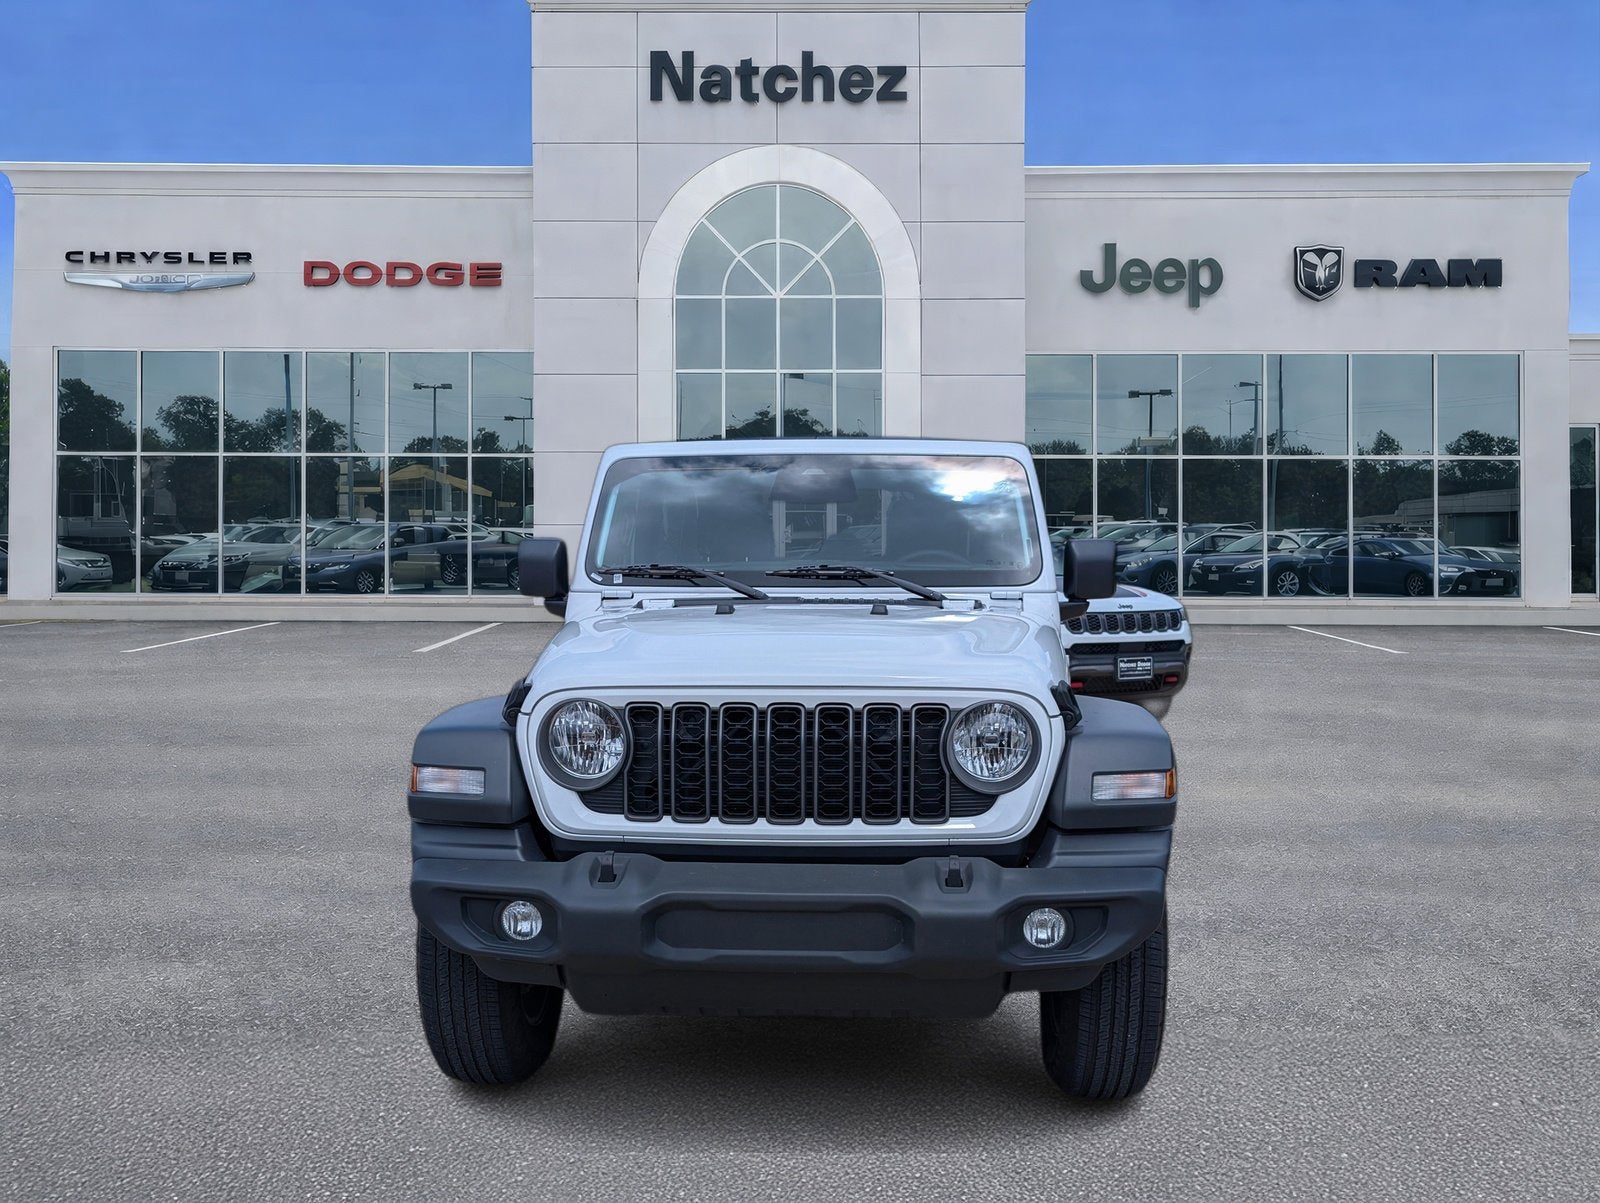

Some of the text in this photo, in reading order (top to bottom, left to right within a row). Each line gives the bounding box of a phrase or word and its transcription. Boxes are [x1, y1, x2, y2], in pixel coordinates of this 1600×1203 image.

[650, 51, 908, 102] Natchez
[65, 250, 253, 265] CHRYSLER
[304, 261, 502, 287] DODGE
[1080, 243, 1223, 308] Jeep
[1354, 259, 1503, 288] RAM
